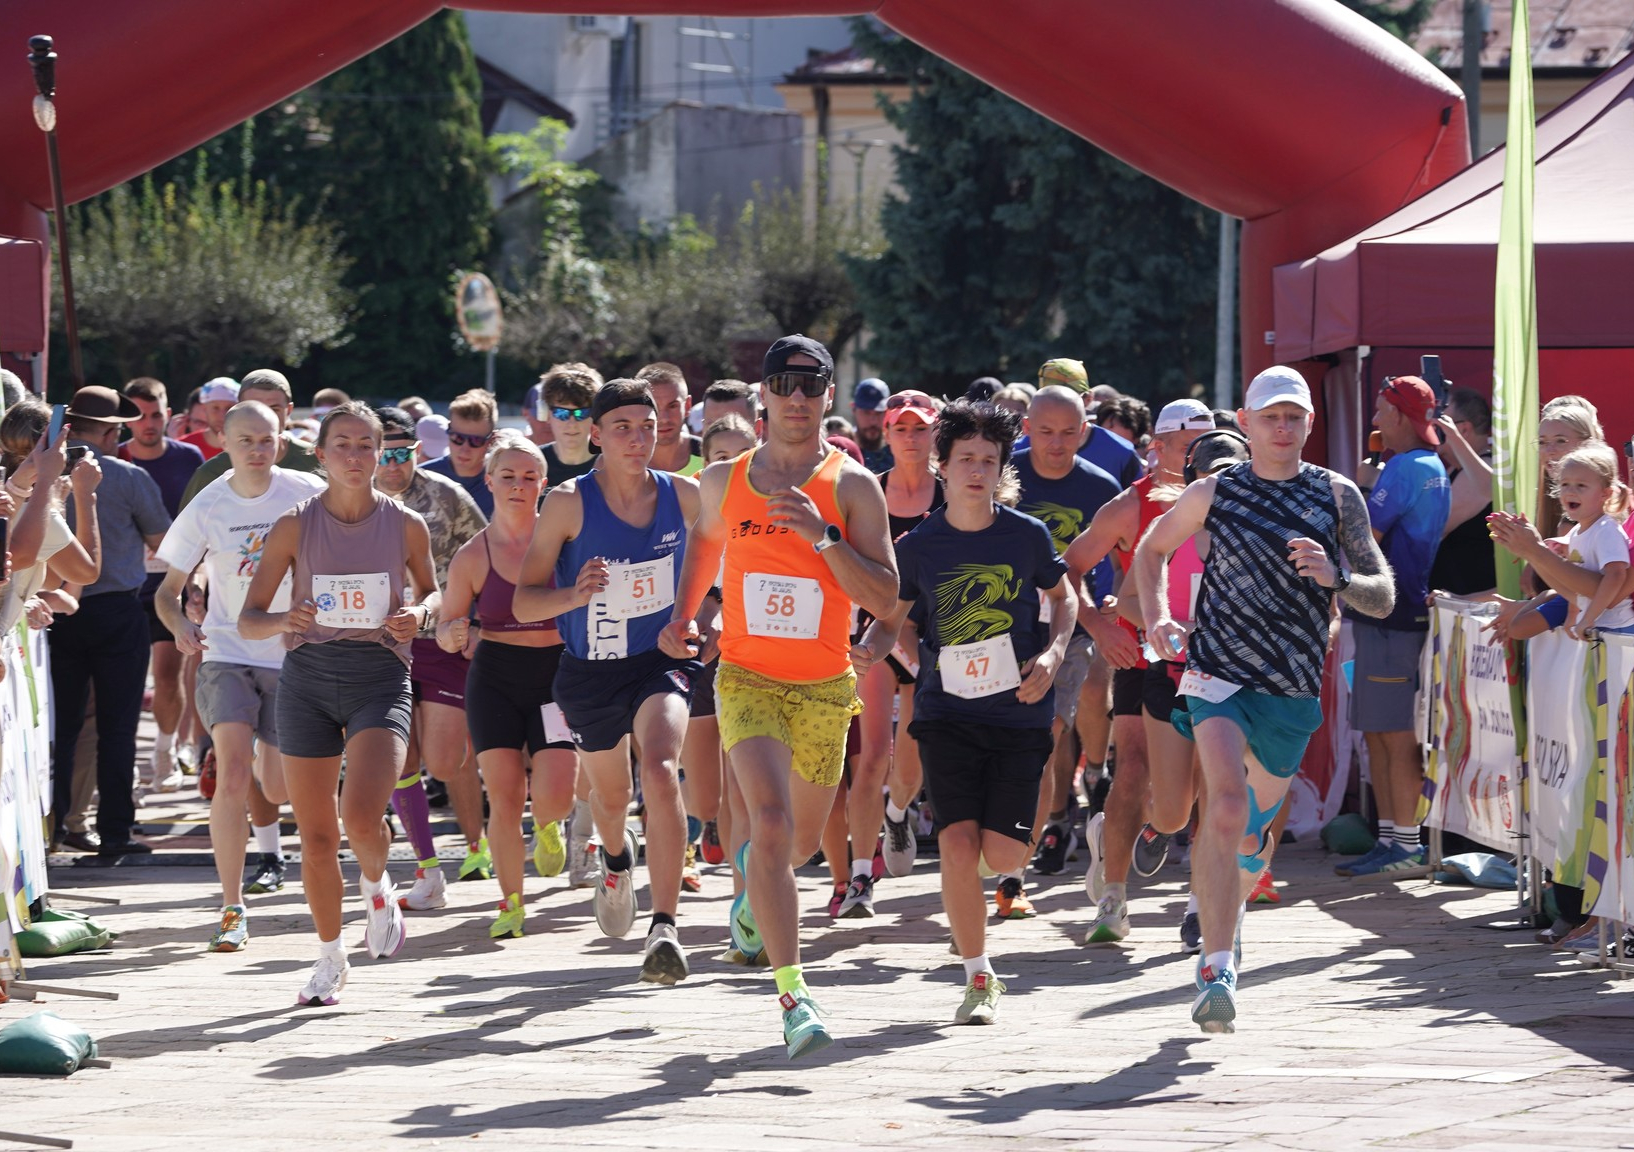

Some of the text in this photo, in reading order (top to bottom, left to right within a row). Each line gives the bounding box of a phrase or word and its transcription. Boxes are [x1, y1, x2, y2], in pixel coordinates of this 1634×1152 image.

[632, 577, 655, 599] 51
[339, 590, 366, 610] 18
[764, 593, 795, 617] 58
[965, 657, 990, 679] 47
